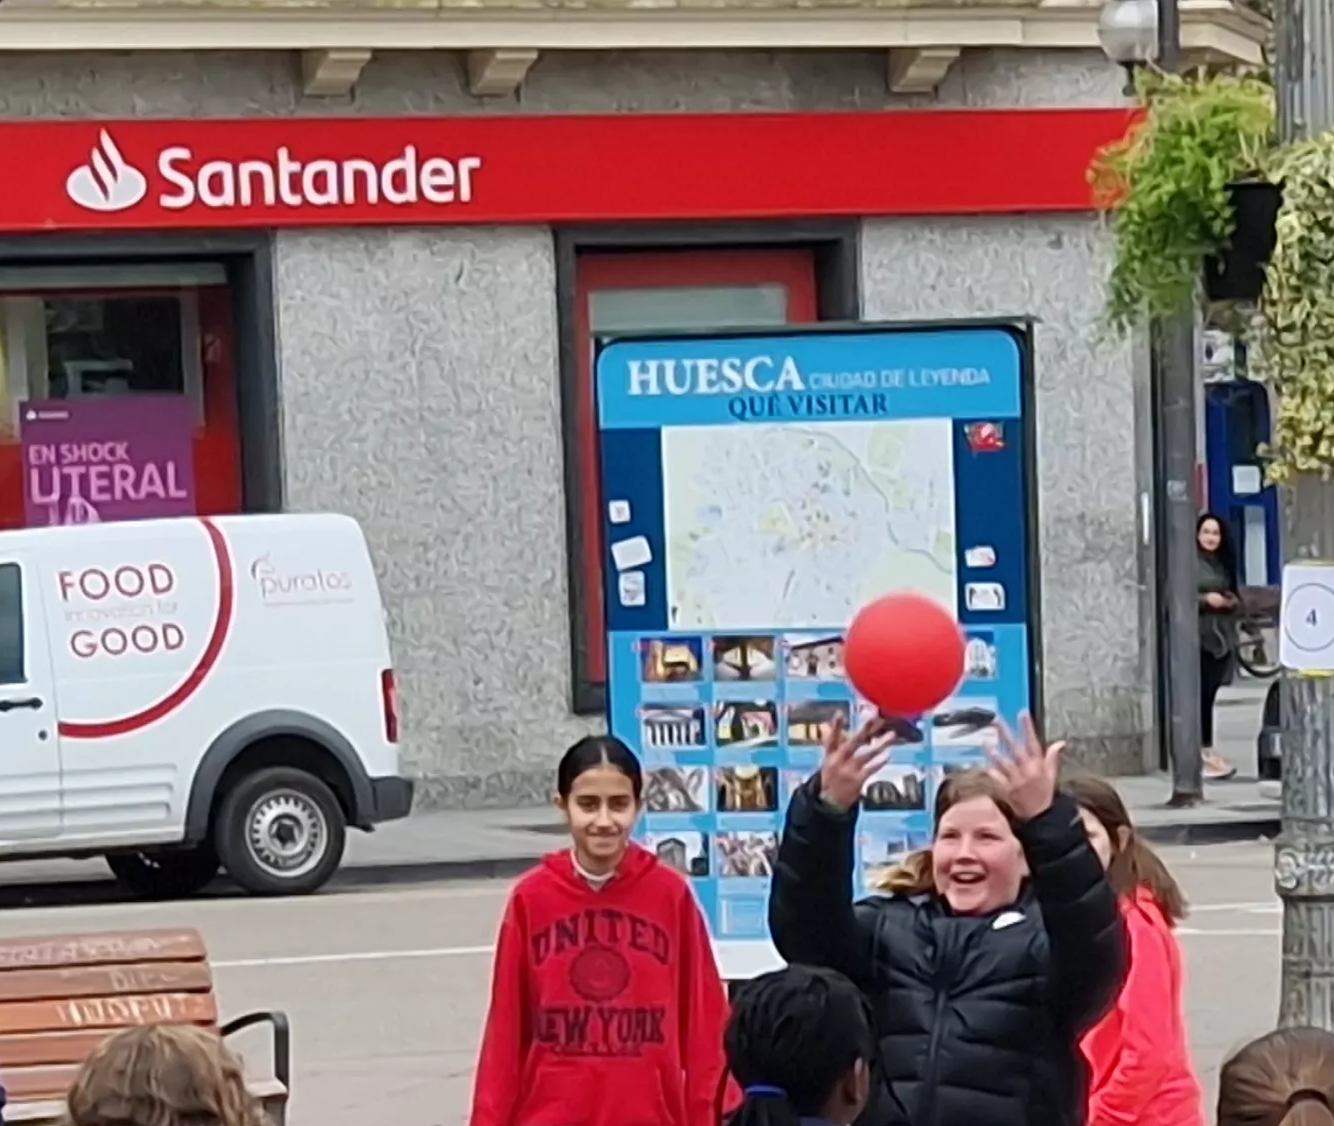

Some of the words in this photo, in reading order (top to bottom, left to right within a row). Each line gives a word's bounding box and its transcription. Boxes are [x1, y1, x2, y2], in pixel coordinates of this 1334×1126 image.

[158, 144, 482, 208] Santander
[626, 355, 806, 396] HUESCA
[809, 369, 875, 390] CIUDAD
[880, 368, 905, 388] DE
[908, 366, 991, 387] LEYENDA
[787, 392, 889, 417] VISITAR
[28, 443, 55, 465] EN
[60, 441, 131, 464] SHOCK
[58, 563, 174, 602] FOOD
[1305, 607, 1318, 628] 4
[70, 622, 185, 659] GOOD
[531, 909, 670, 967] UNITED
[596, 1006, 666, 1044] YORK
